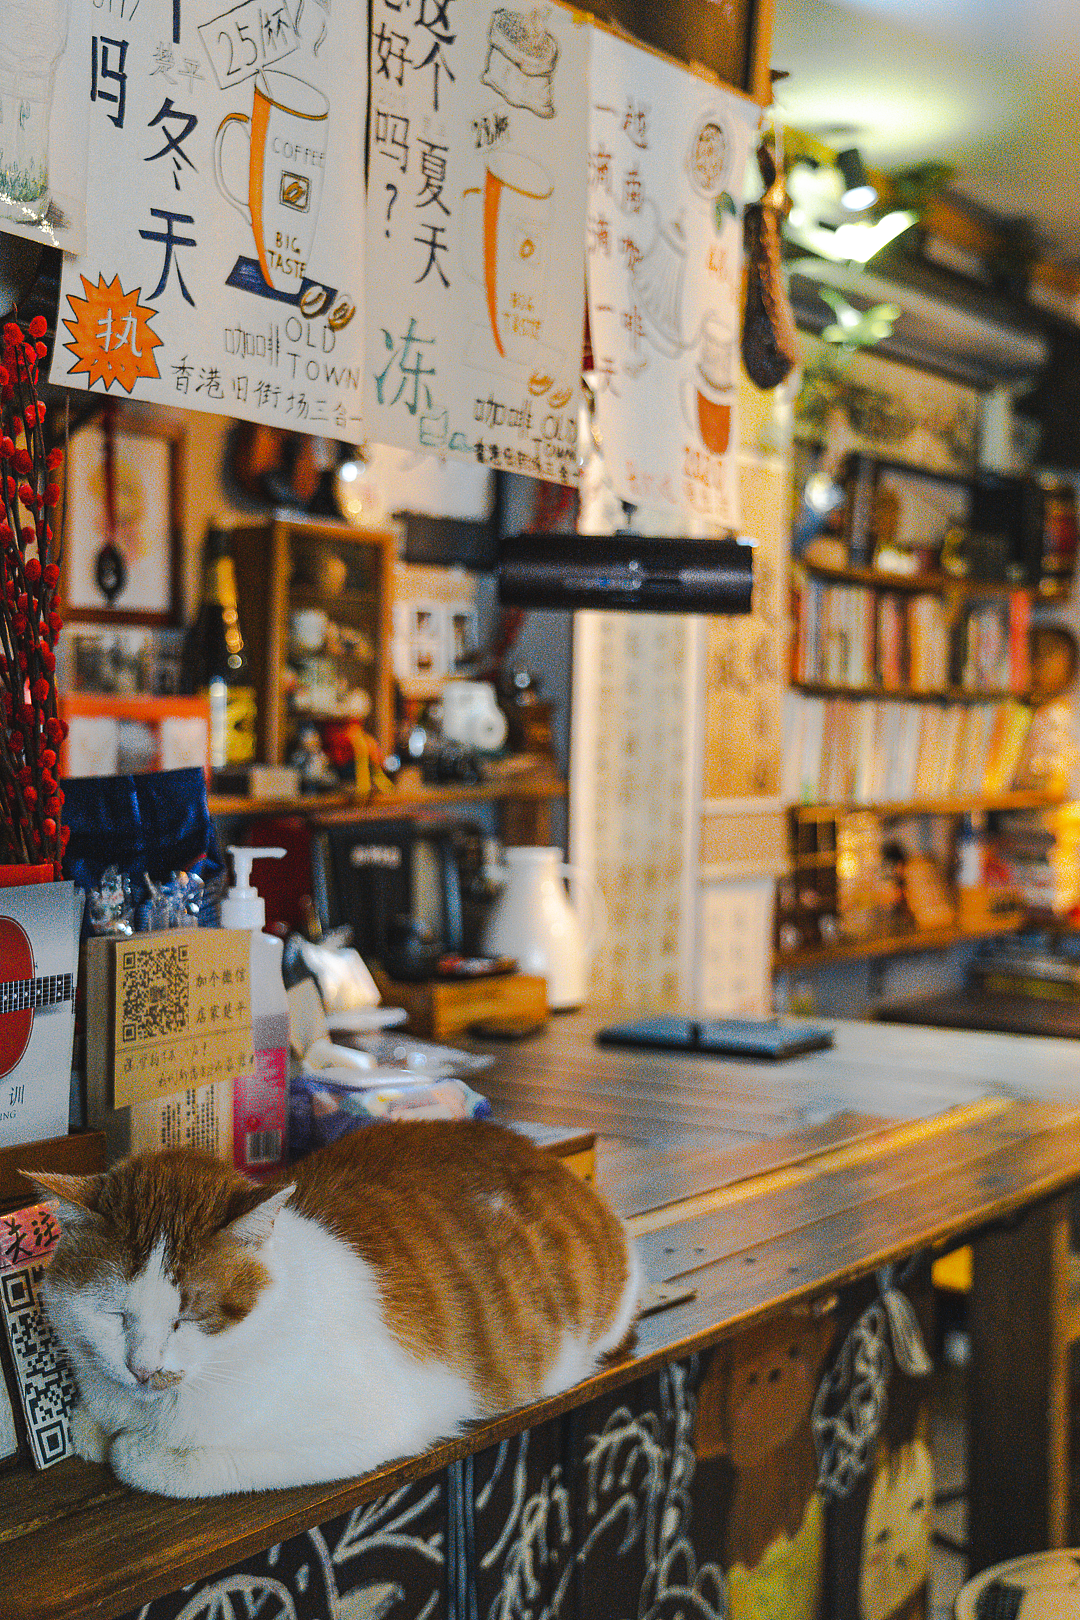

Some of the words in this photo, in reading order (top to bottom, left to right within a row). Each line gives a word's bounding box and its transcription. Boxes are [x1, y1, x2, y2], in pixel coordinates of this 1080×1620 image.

[90, 35, 130, 129] 吗
[372, 0, 411, 239] 好吗?
[272, 136, 327, 169] COFFEE
[267, 249, 307, 280] TASTE
[275, 231, 301, 254] BIG
[95, 306, 144, 373] 热
[223, 321, 281, 367] 咖啡
[285, 315, 336, 354] OLD
[372, 316, 436, 417] 冻
[170, 355, 364, 429] 香港旧街场三合一
[286, 352, 361, 391] TOWN
